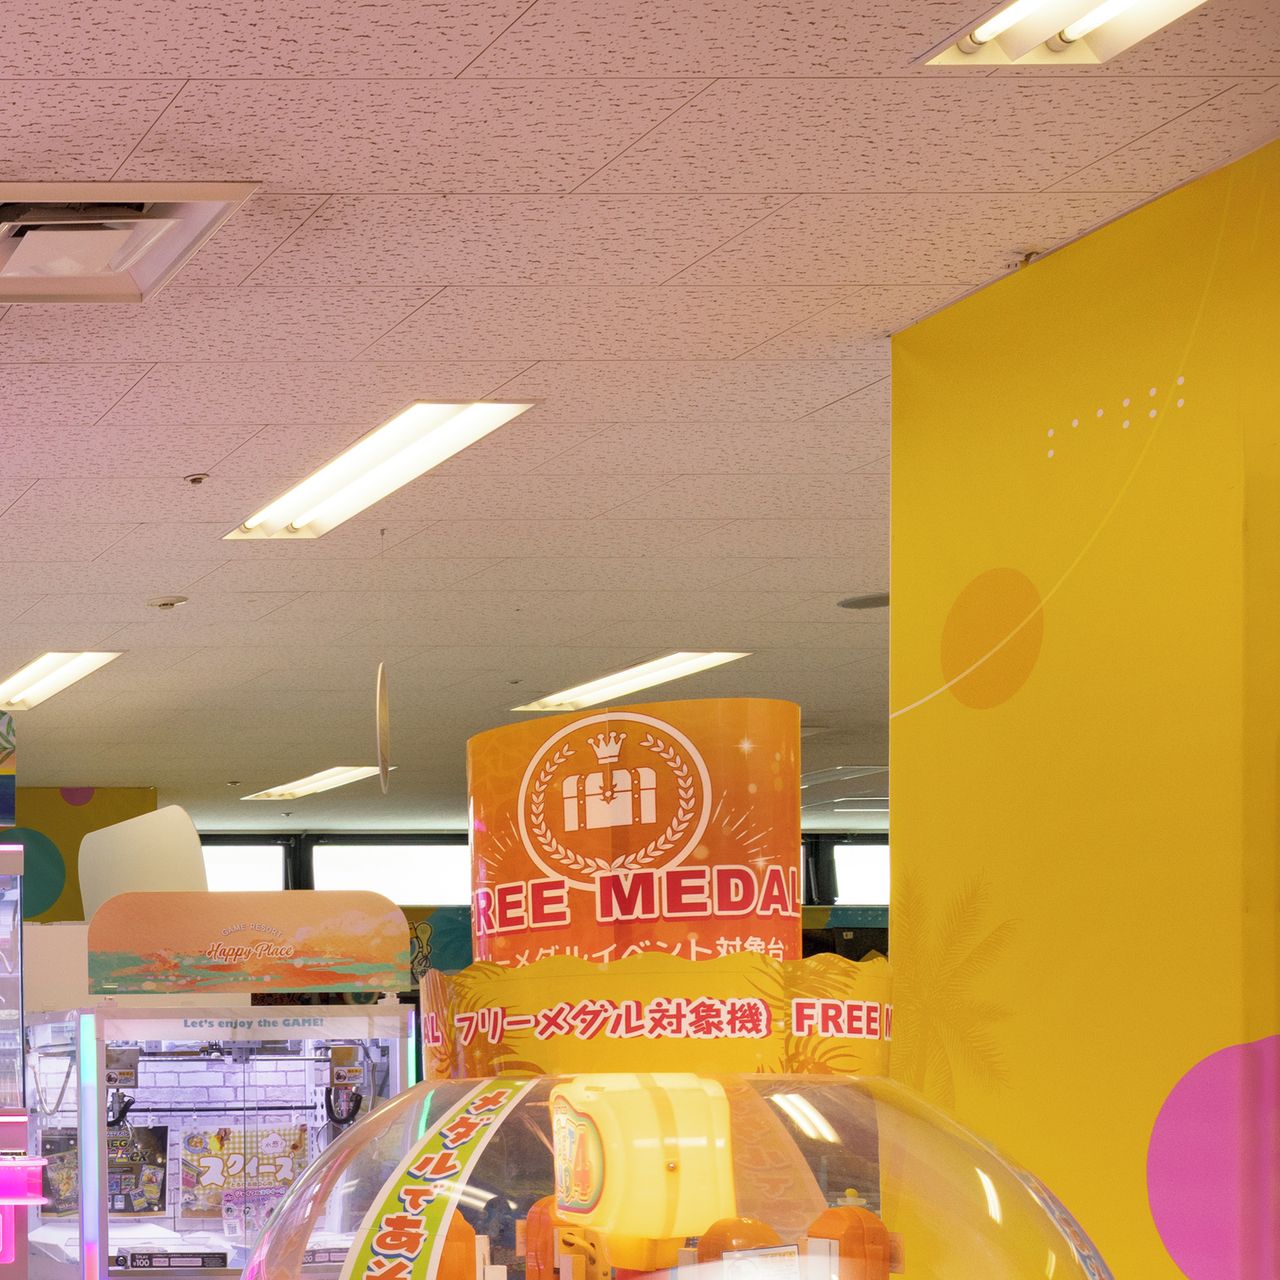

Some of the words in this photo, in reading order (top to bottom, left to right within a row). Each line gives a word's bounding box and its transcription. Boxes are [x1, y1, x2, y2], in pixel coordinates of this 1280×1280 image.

[472, 880, 572, 935] REE
[221, 923, 248, 937] GAME
[249, 922, 283, 938] RESORT
[206, 941, 254, 962] Happy
[252, 941, 294, 959] Place
[183, 1018, 215, 1029] Let's
[217, 1018, 254, 1031] enjoy
[257, 1018, 279, 1029] the
[282, 1018, 324, 1029] GAME!
[455, 997, 770, 1045] フリーメダル対象機
[790, 999, 882, 1038] FREE
